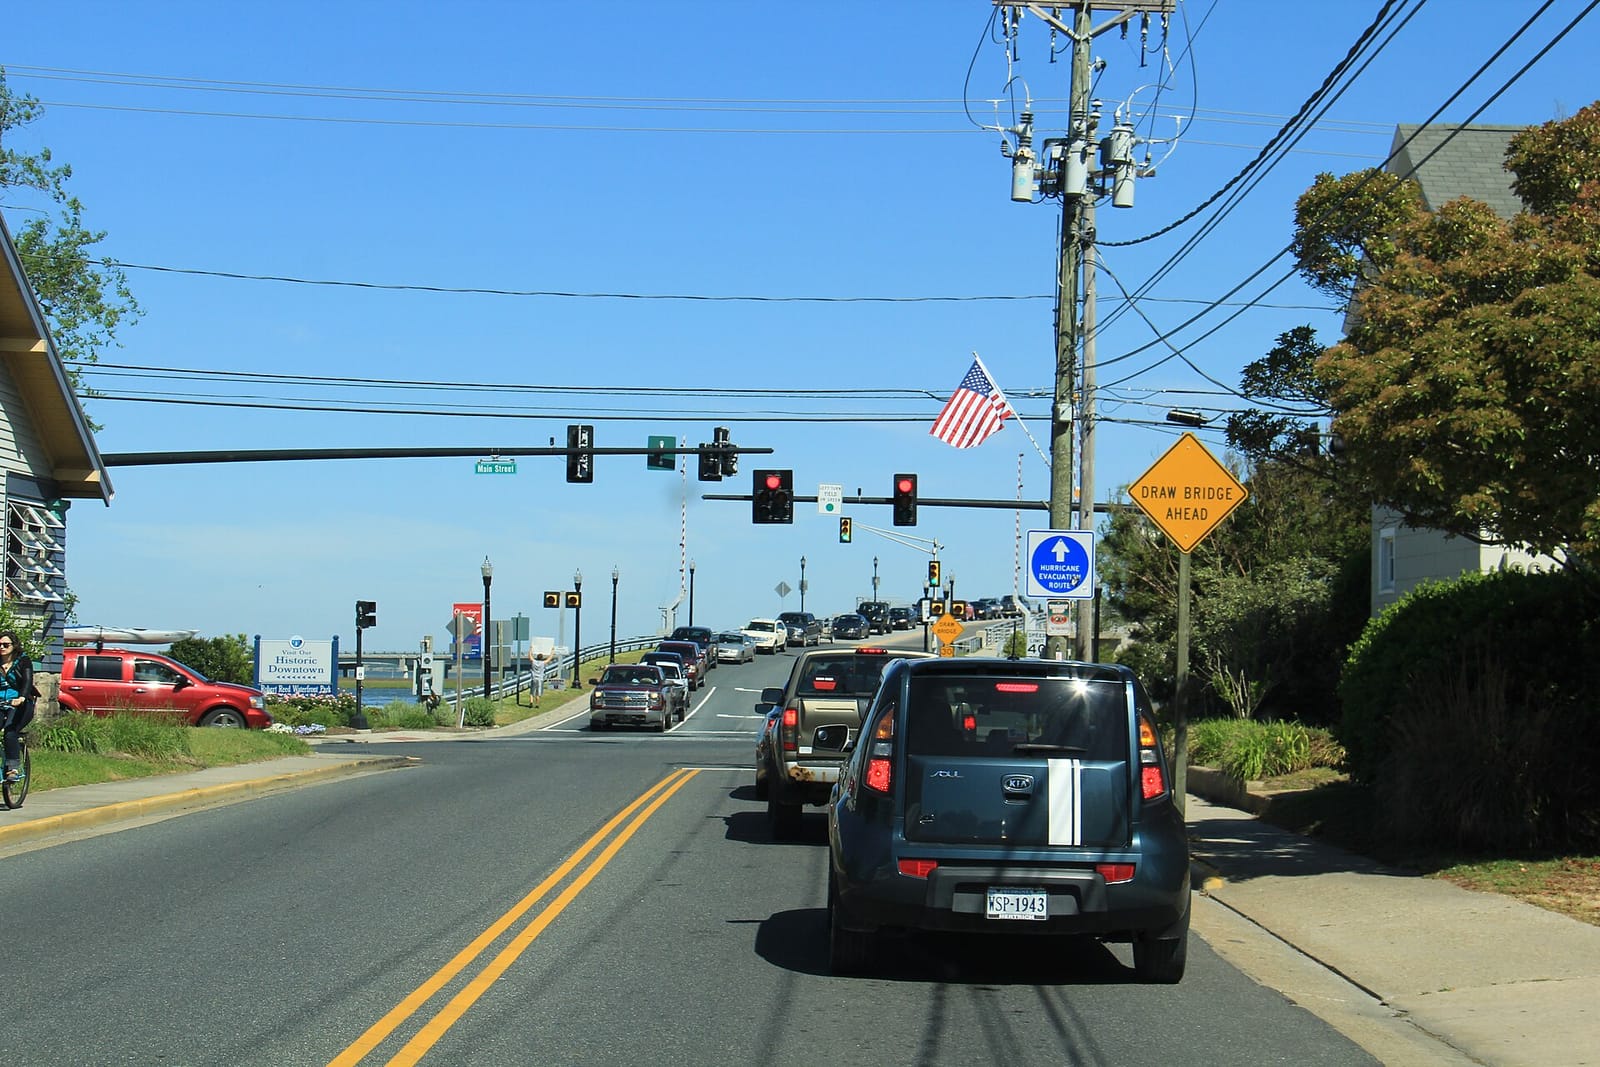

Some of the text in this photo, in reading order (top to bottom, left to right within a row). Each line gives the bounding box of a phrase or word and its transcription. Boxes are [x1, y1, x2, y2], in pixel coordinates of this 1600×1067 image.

[477, 463, 514, 473] Main Street
[1141, 486, 1233, 500] DRAW BRIDGE
[1166, 507, 1208, 520] AHEAD
[1040, 564, 1080, 572] HURRICANE
[1049, 581, 1071, 589] ROUTE
[276, 656, 318, 665] Historic
[268, 665, 324, 674] Downtown
[1009, 780, 1027, 788] KIA
[988, 897, 1045, 912] WSP-1943
